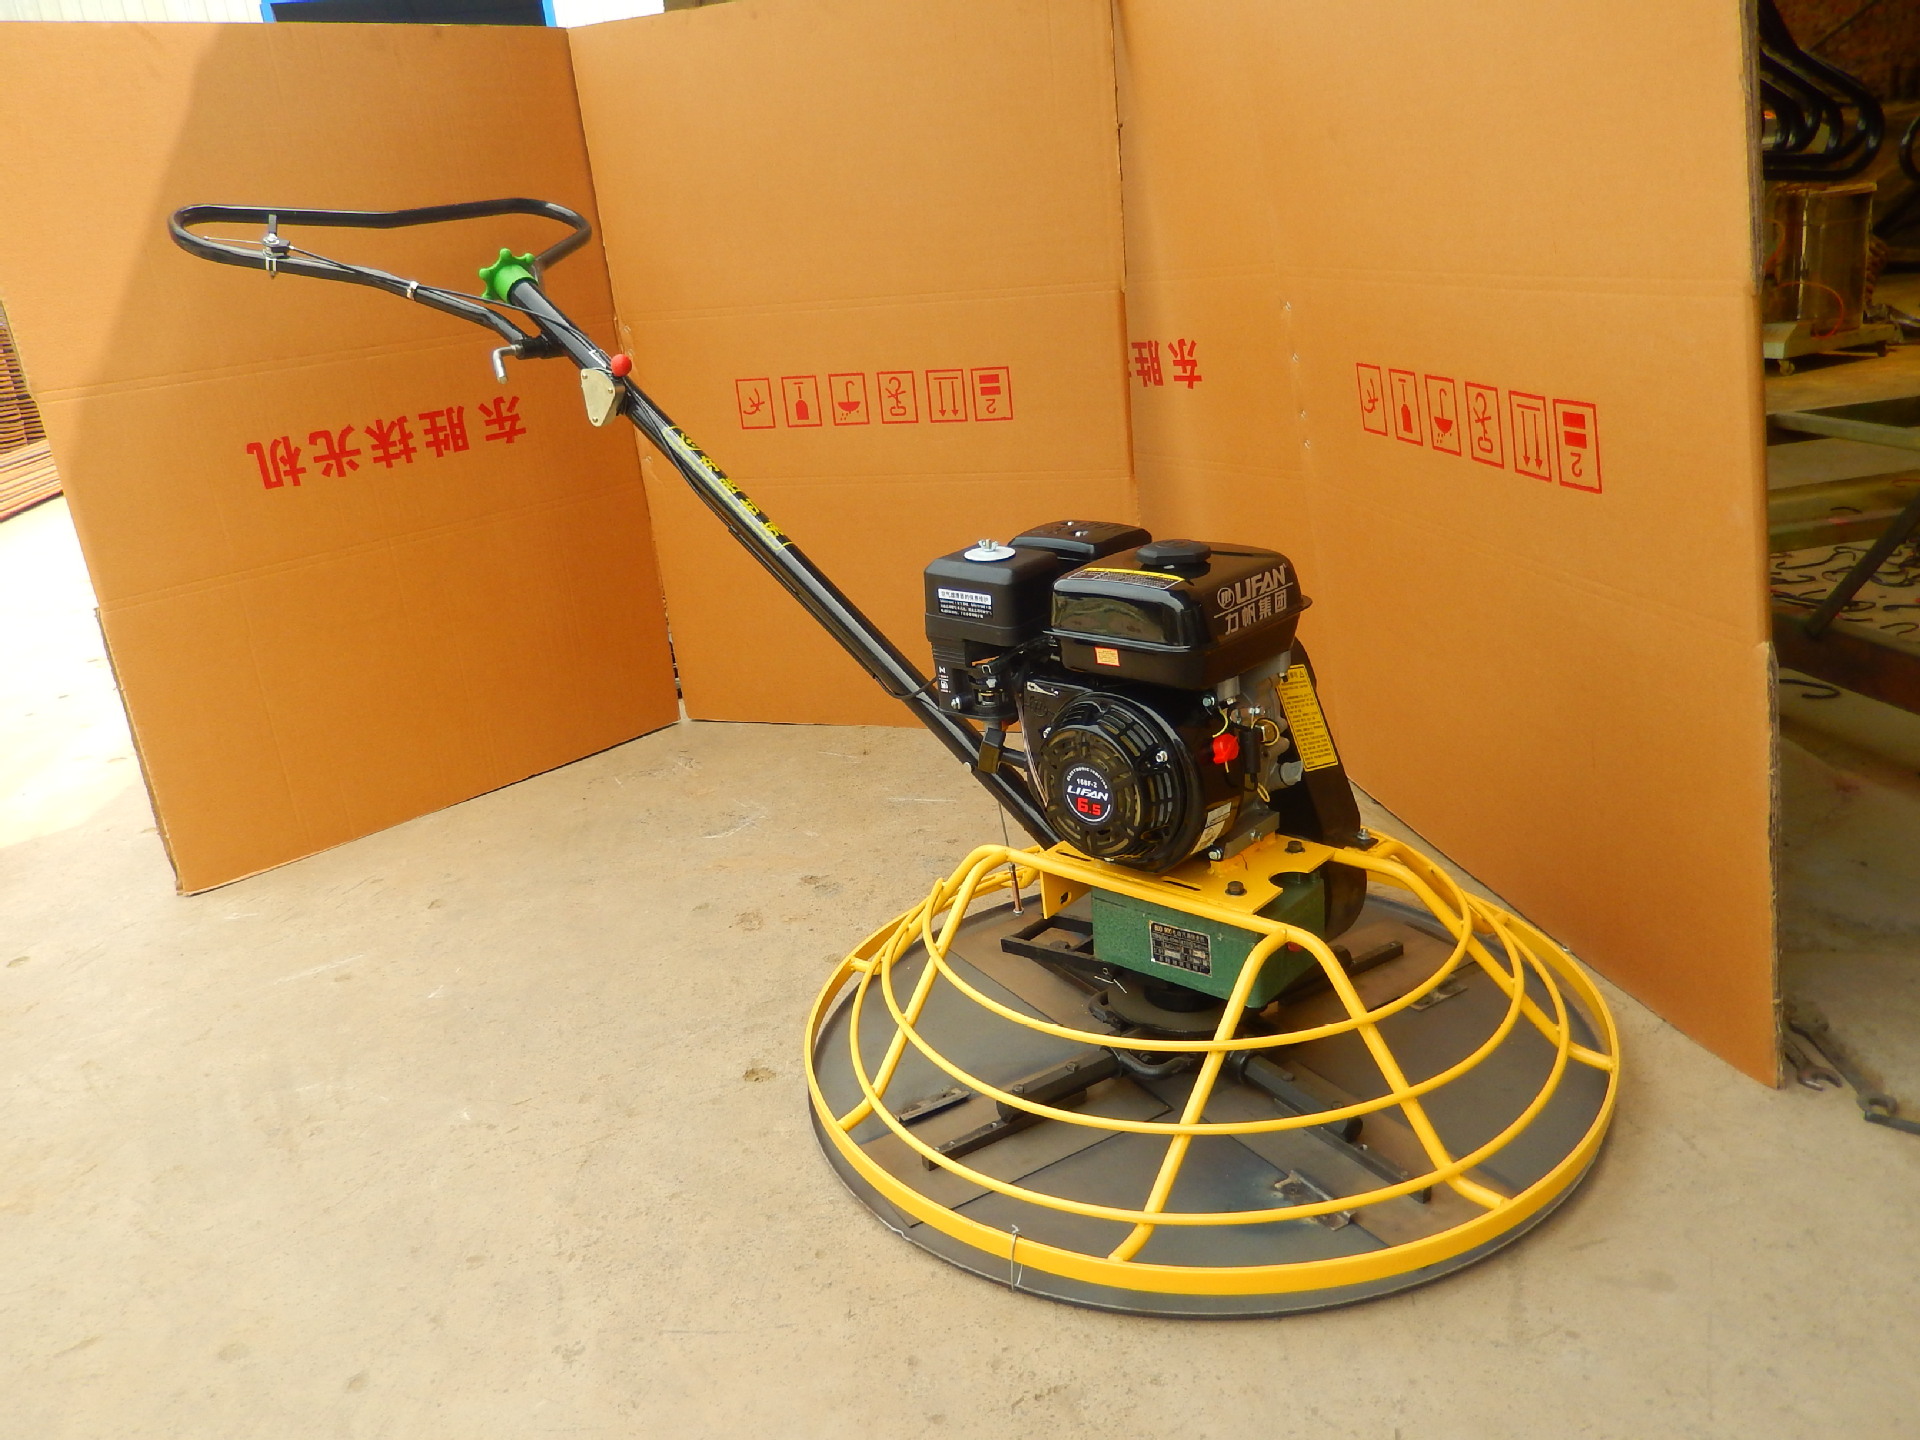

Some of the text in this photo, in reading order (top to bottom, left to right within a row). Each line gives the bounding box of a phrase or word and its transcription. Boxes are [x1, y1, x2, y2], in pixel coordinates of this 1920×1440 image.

[1128, 338, 1203, 390] 东胜
[246, 396, 527, 490] 东胜抹光机
[1234, 564, 1287, 604] LIFAN
[1225, 588, 1287, 636] 力帆集团
[1067, 784, 1109, 802] LIFAN
[1077, 797, 1101, 816] 6.5
